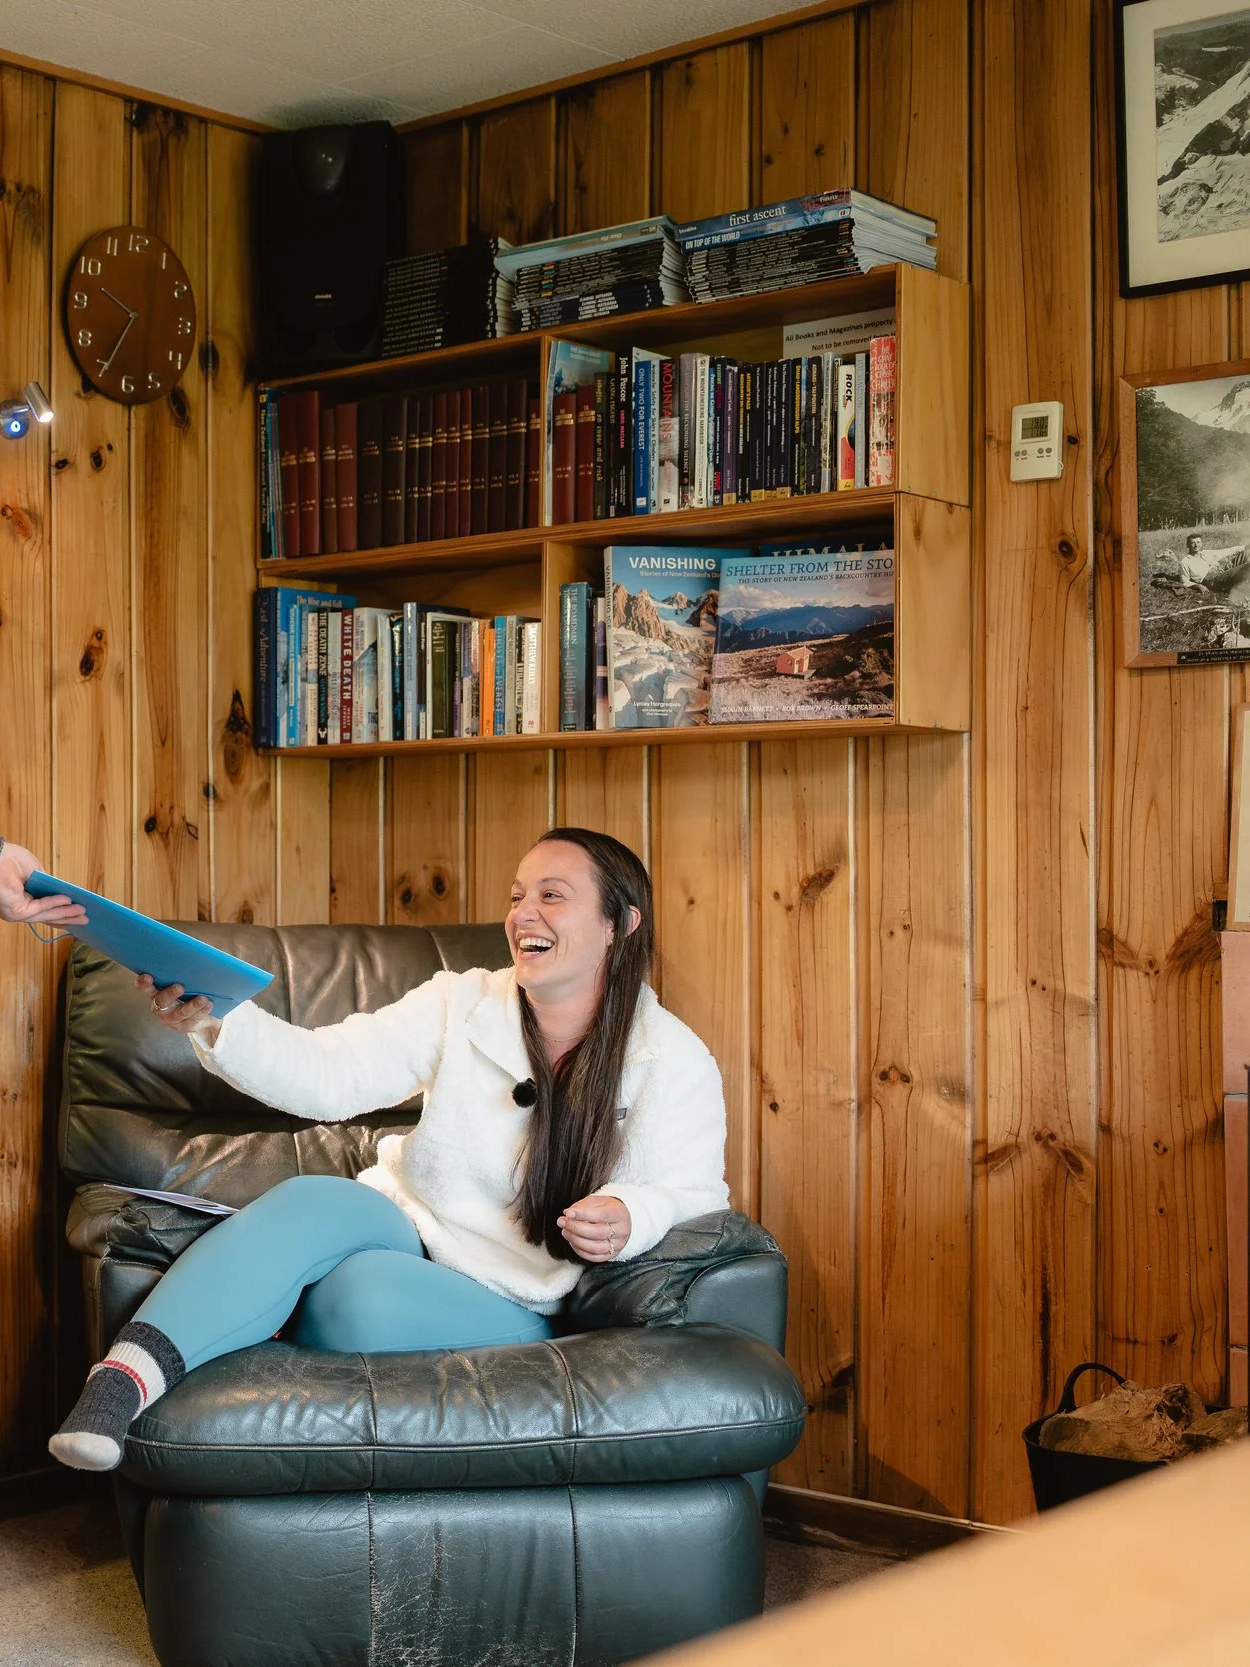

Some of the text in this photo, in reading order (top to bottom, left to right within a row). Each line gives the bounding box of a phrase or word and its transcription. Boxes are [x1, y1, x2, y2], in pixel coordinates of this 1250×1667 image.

[729, 213, 750, 227] first
[753, 205, 786, 221] ascent
[107, 236, 118, 256] 11
[129, 233, 149, 254] 12
[685, 231, 740, 250] ON TOP OF THE WORLD
[81, 255, 102, 277] 10
[161, 252, 167, 270] 1
[73, 291, 88, 310] 9
[174, 281, 188, 300] 2
[178, 317, 191, 335] 3
[795, 332, 814, 341] Books
[815, 329, 828, 337] and
[829, 322, 863, 334] Magazines
[864, 319, 893, 330] property
[78, 328, 92, 348] 8
[812, 343, 824, 352] Not
[825, 342, 832, 350] to
[843, 335, 871, 347] removed
[620, 357, 628, 402] John Pascoe
[661, 362, 674, 442] MOUNTAINS
[629, 556, 716, 571] VANISHING
[726, 557, 894, 578] SHELTER FROM THE STO
[835, 571, 881, 580] BACKCOUNTRY
[319, 612, 327, 627] THE
[319, 628, 327, 653] DEATH
[496, 627, 504, 664] GHOSTS
[528, 627, 538, 663] MATTHEW
[259, 632, 270, 682] Adventure
[319, 654, 327, 677] ZONE
[343, 614, 352, 699] WHITE DEATH
[496, 676, 504, 712] EVEREST
[852, 703, 894, 711] SPEARPOINT
